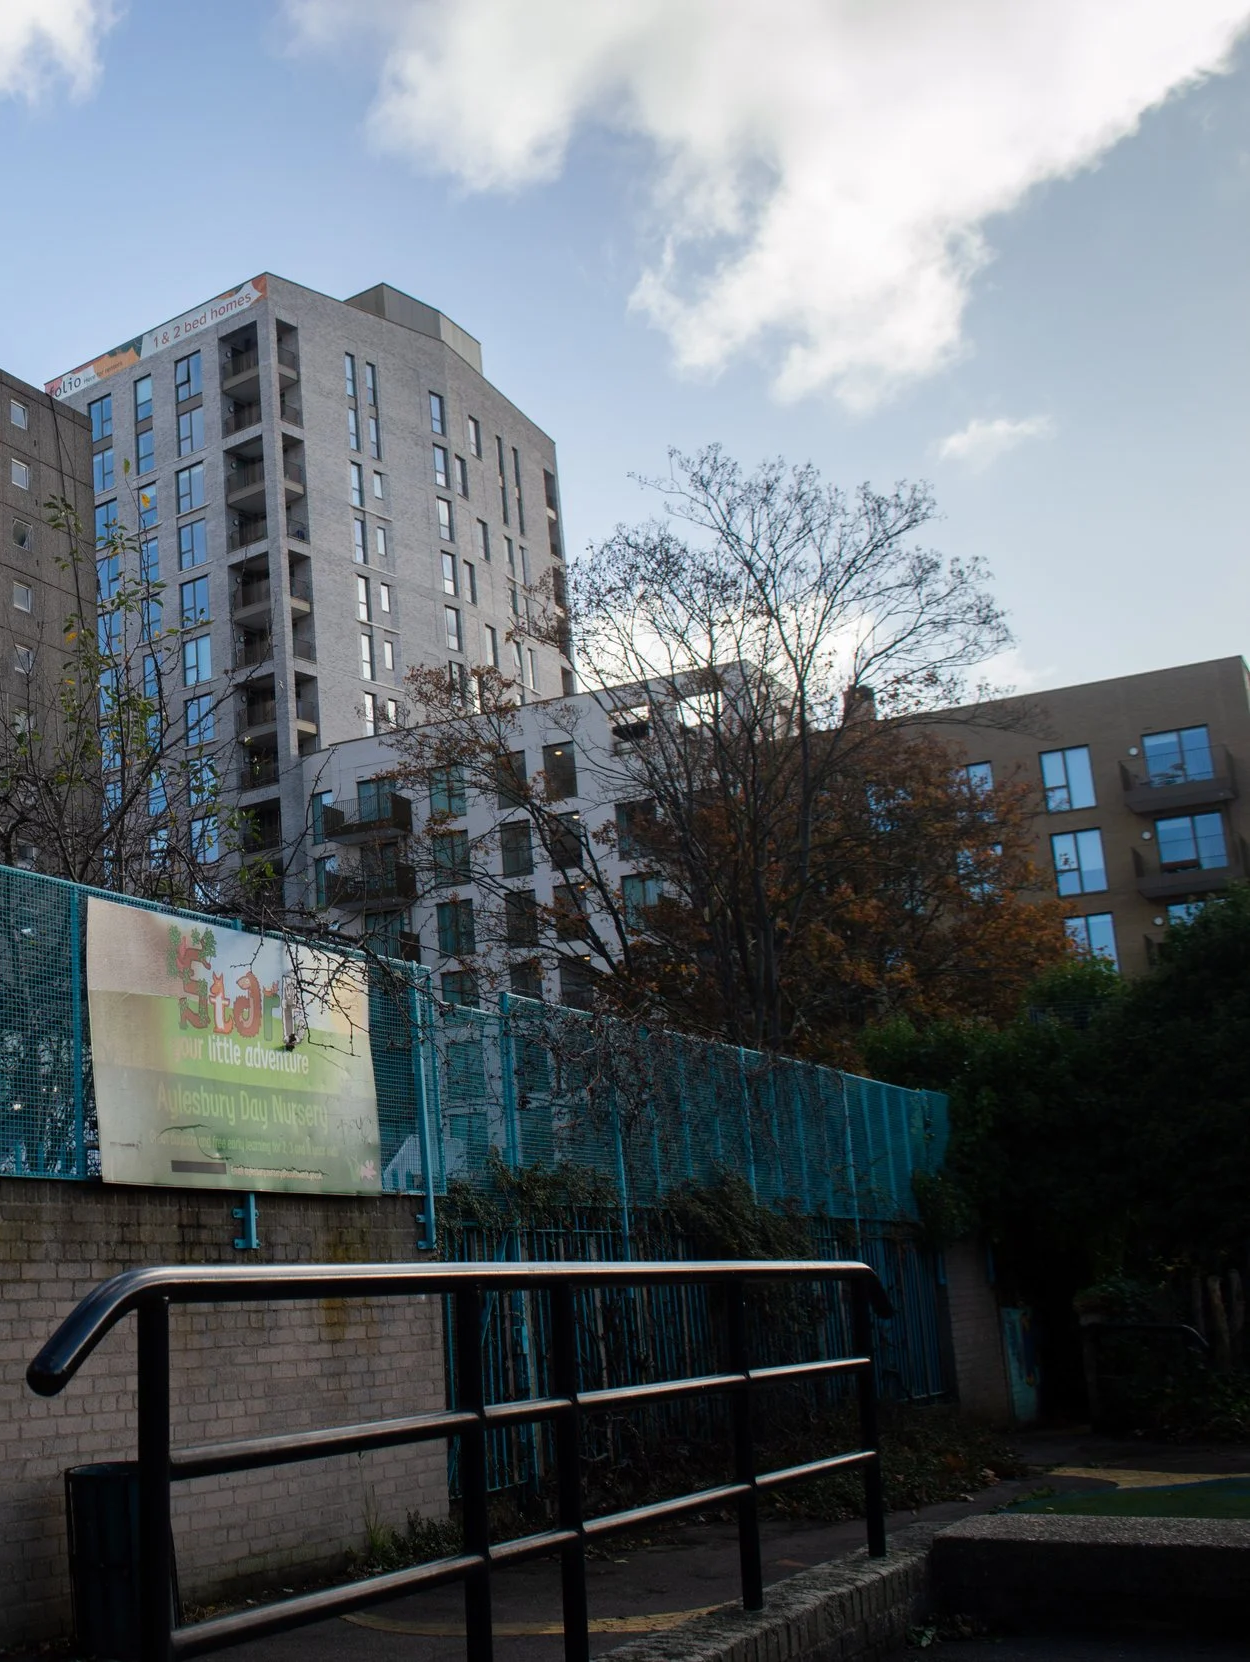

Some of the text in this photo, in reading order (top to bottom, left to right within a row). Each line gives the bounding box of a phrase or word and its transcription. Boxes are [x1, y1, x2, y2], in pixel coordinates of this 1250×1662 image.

[154, 293, 252, 349] 1 & 2 bed homes
[49, 377, 82, 398] folio
[169, 1035, 310, 1074] your little adventure
[157, 1081, 236, 1126] Aylesbury
[240, 1090, 268, 1129] Day
[272, 1094, 328, 1134] Nursery
